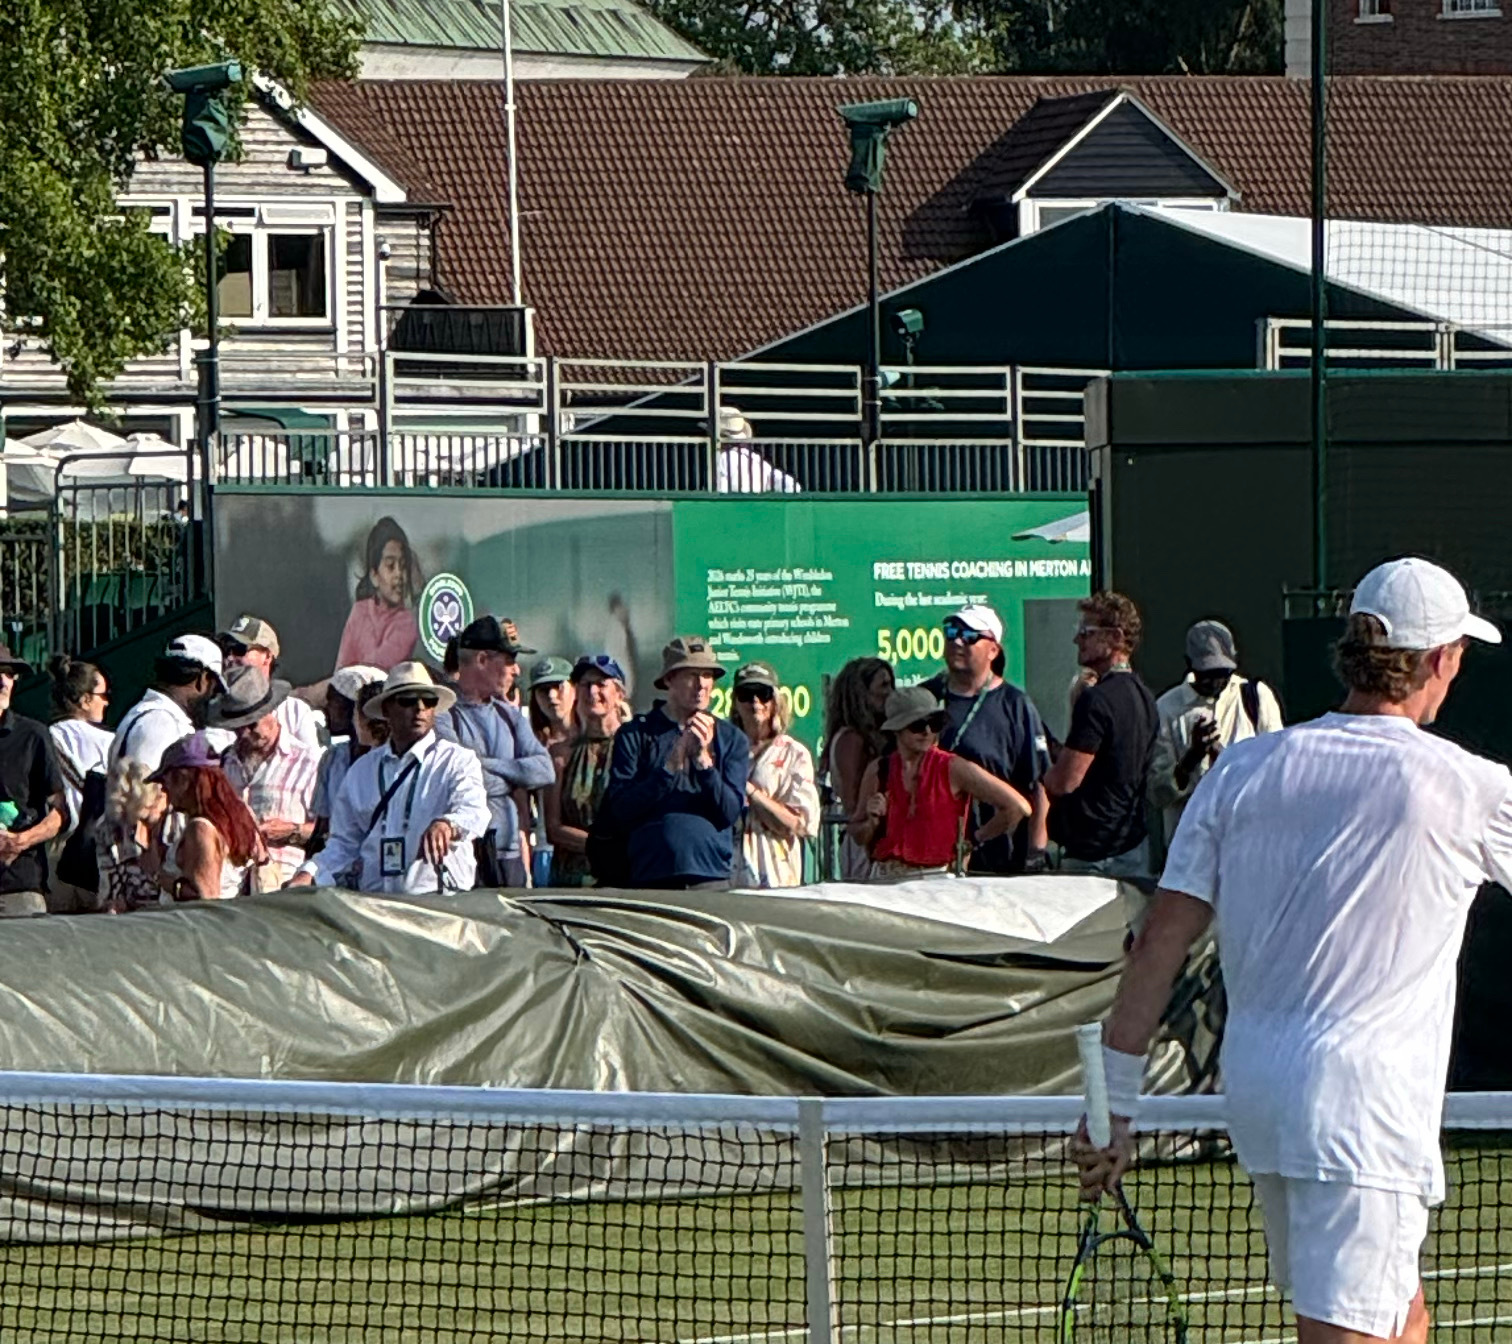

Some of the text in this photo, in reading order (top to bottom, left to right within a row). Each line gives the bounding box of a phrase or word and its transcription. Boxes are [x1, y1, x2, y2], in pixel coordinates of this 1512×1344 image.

[874, 562, 905, 580] FREE
[907, 561, 950, 580] TENNIS
[951, 560, 1013, 578] COACHING
[1015, 560, 1028, 577] IN
[1029, 559, 1077, 577] MERTON
[875, 591, 904, 610] During
[905, 592, 918, 606] the
[878, 627, 945, 665] 5,000
